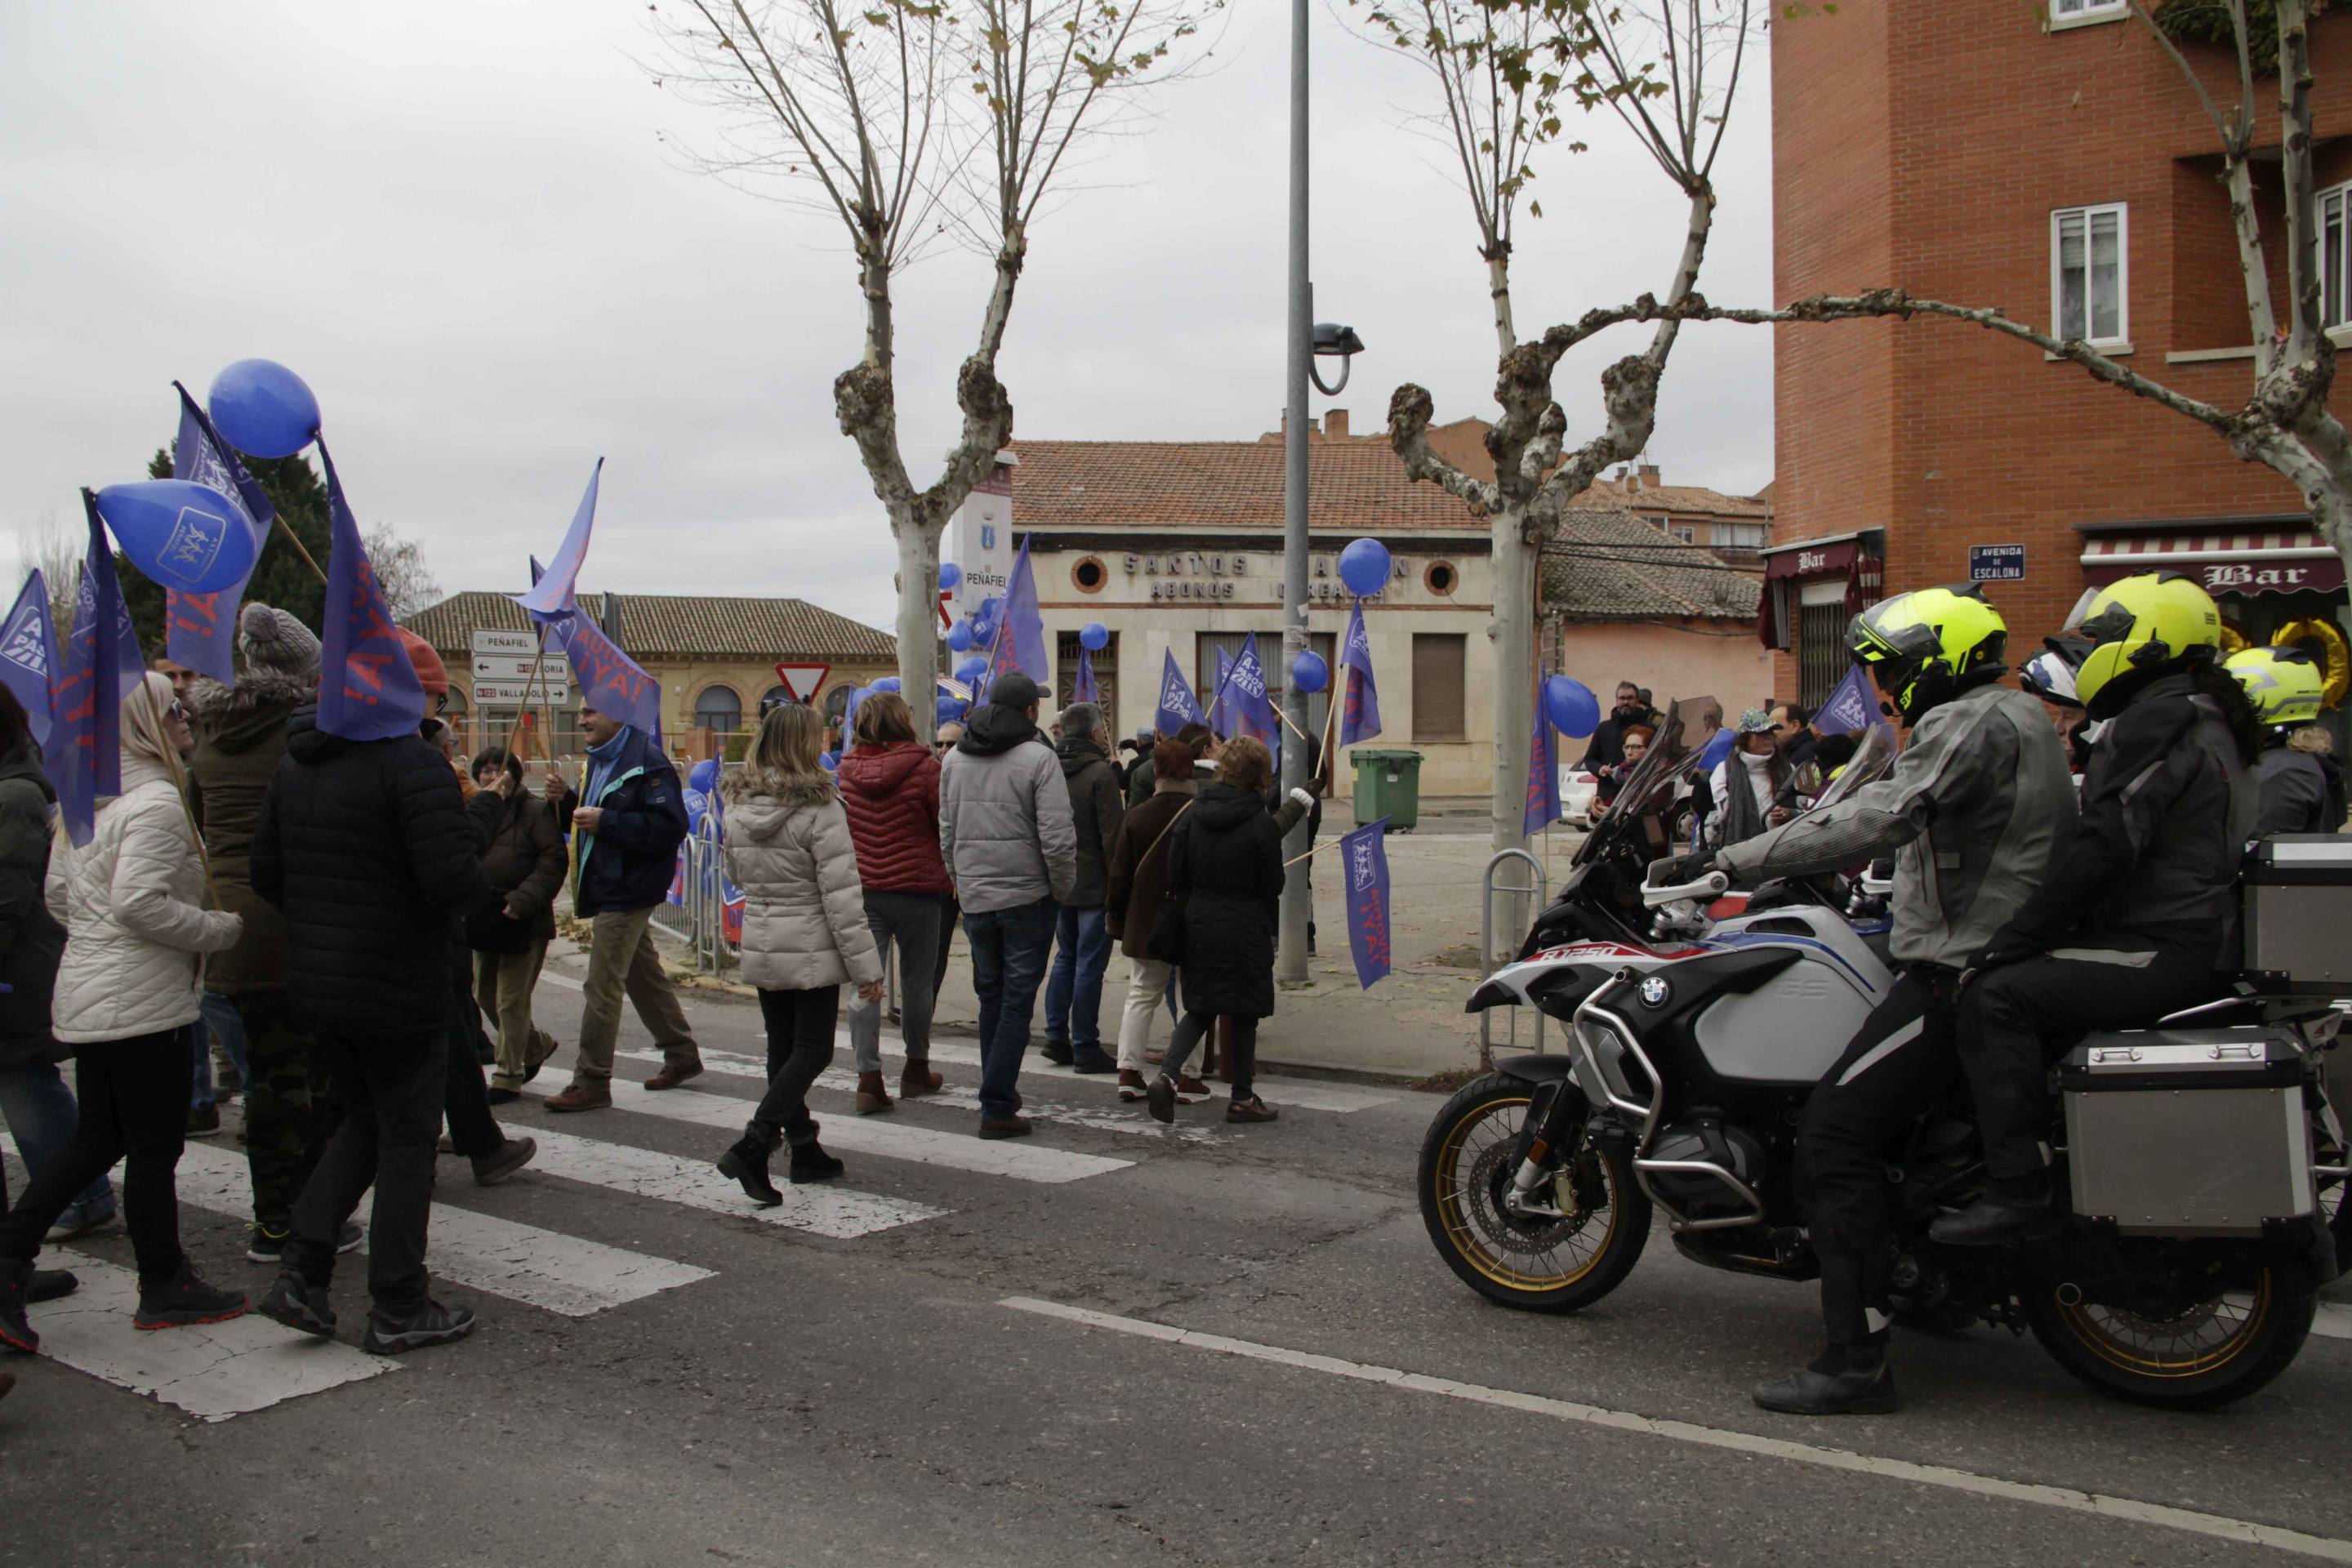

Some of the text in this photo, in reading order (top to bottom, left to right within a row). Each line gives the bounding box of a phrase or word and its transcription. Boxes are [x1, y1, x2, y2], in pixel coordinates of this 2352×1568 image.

[1982, 547, 2022, 556] AVENIDA
[1124, 554, 1247, 575] SANTOS
[1798, 551, 1825, 572] Bar
[1974, 567, 2020, 579] ESCALONA
[2203, 564, 2308, 589] Bar
[1151, 581, 1235, 598] ABONOS
[488, 636, 528, 648] PEÑAFIEL
[1236, 666, 1265, 690] PASOS
[1539, 947, 1618, 961] R1250
